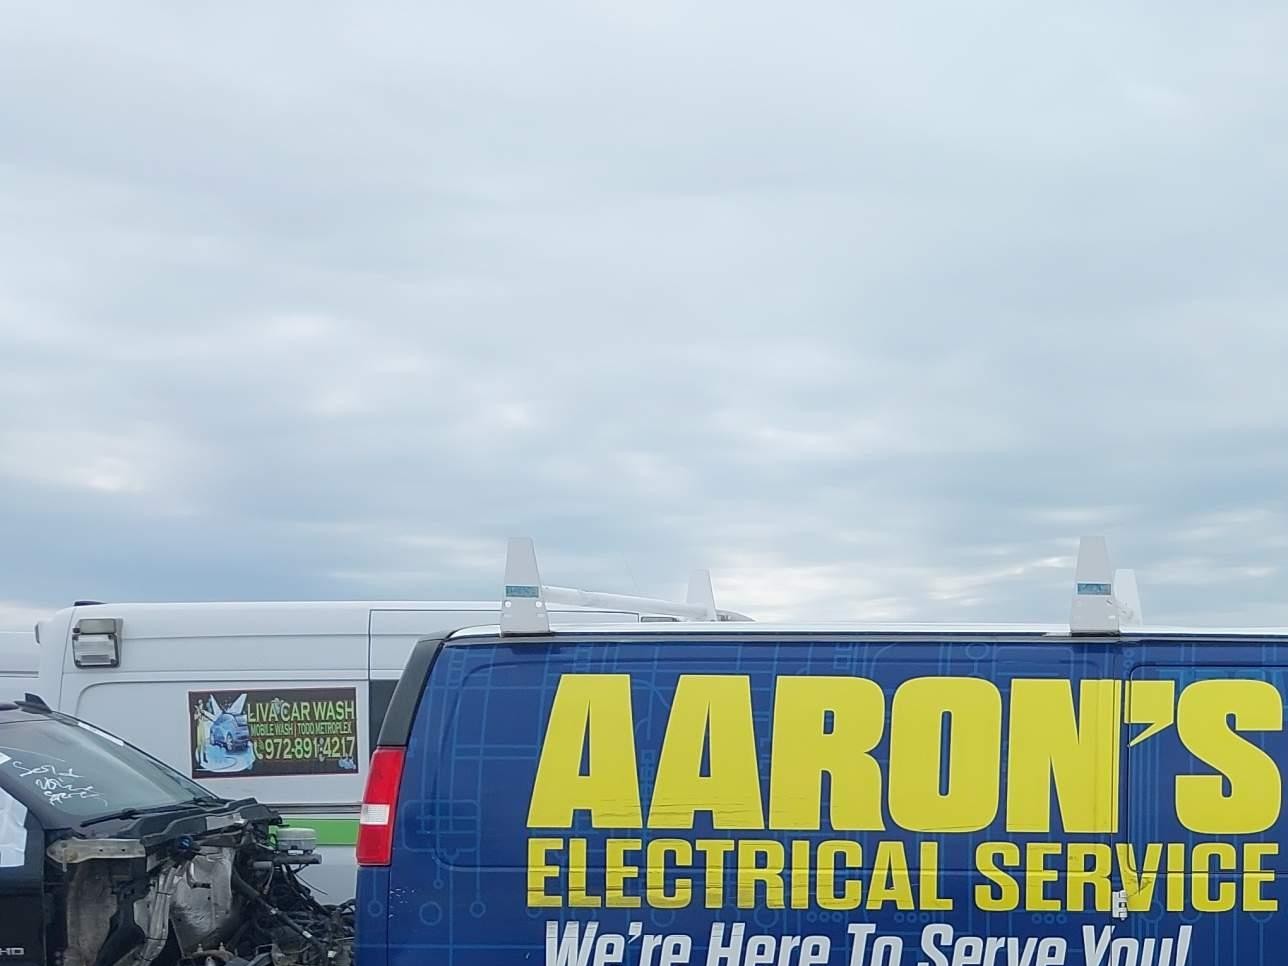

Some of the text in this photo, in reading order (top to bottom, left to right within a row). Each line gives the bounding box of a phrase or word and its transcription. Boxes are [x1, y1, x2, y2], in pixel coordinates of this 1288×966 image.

[275, 723, 293, 736] WASH
[280, 702, 310, 721] CAR
[313, 700, 355, 720] WASH
[527, 674, 1283, 835] AARON'S
[527, 838, 1279, 912] ELECTRICAL SERVICE
